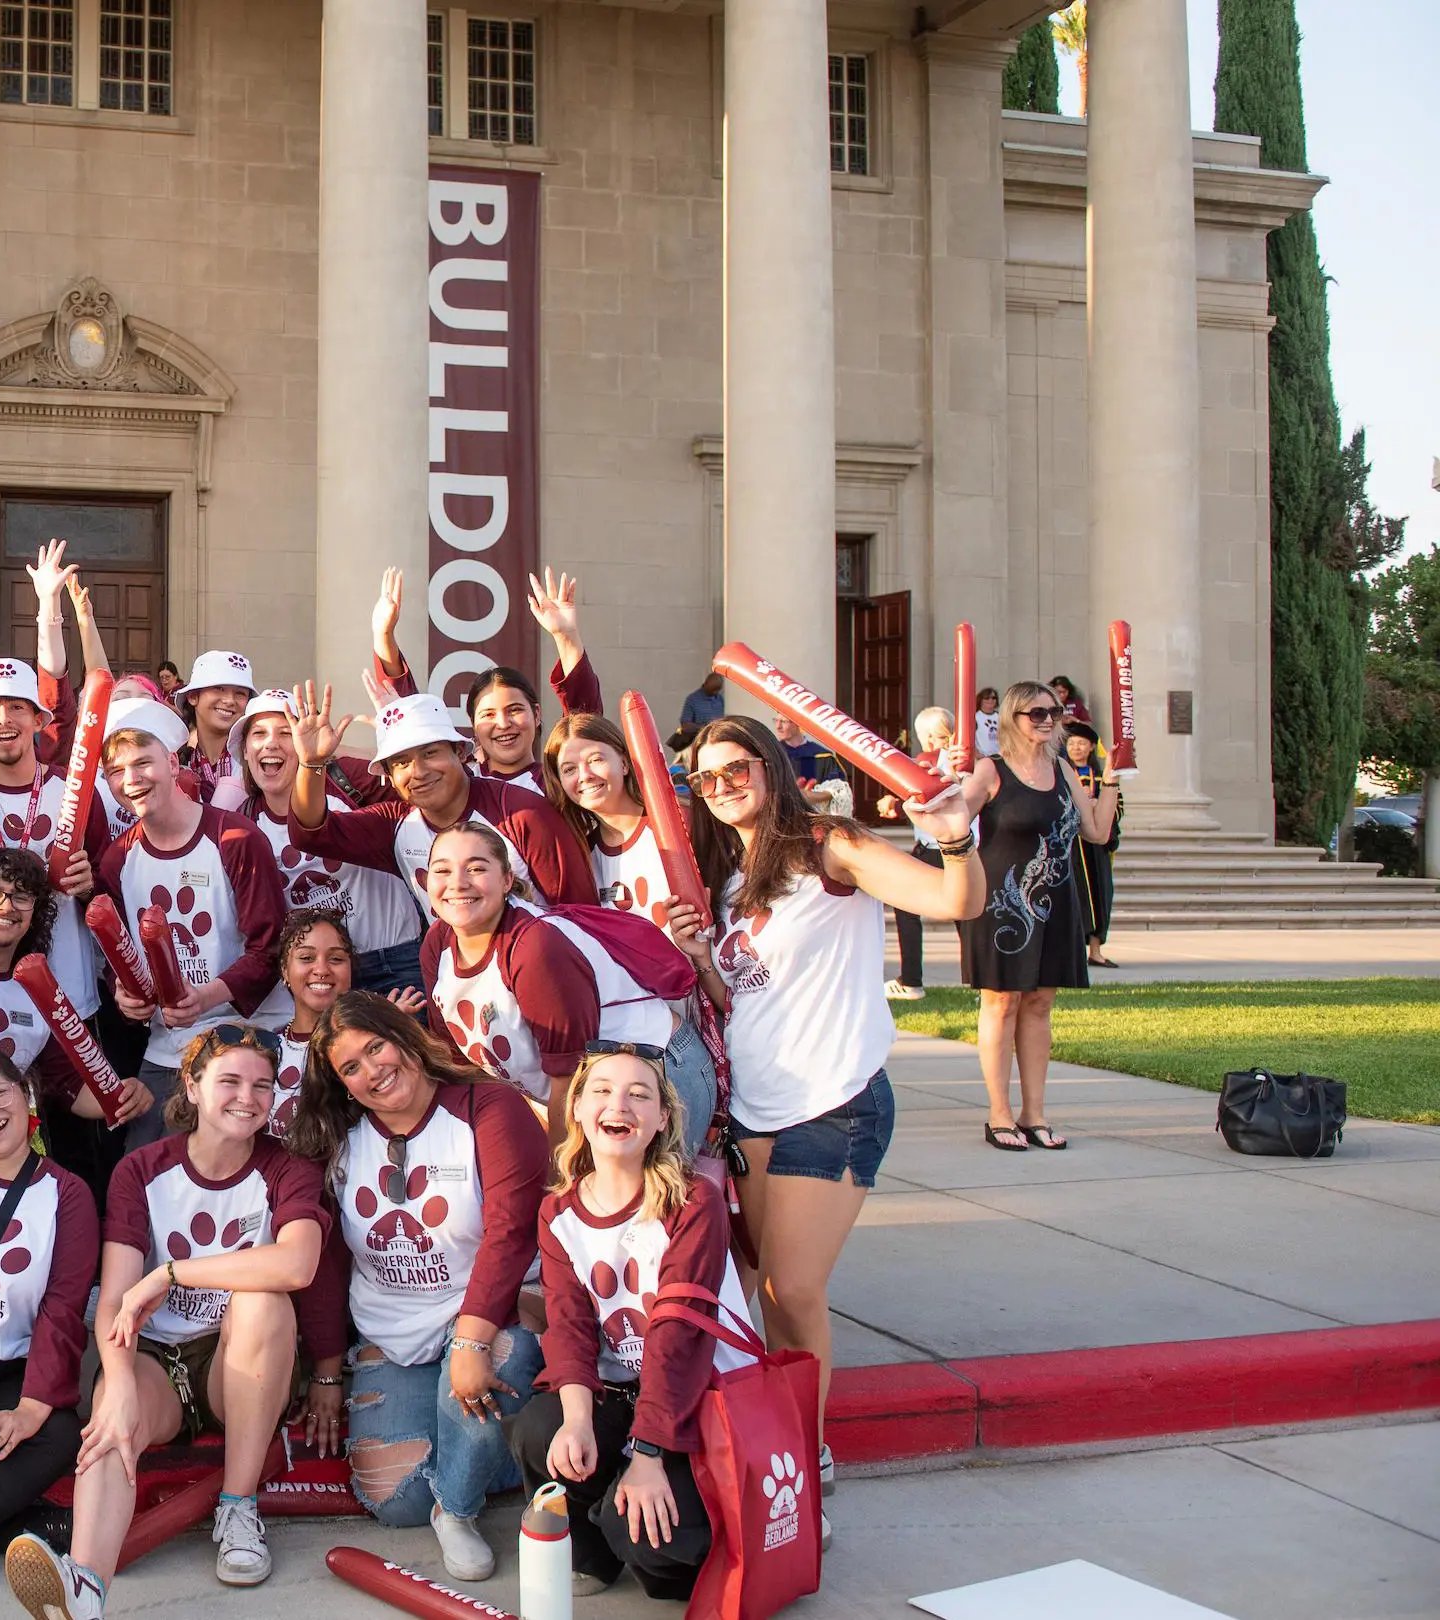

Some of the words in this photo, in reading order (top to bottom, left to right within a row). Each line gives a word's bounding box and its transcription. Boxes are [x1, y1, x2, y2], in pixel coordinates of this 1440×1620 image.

[1118, 667, 1131, 685] GO
[777, 680, 815, 711] GO
[810, 699, 896, 763] DAWGS!
[1119, 689, 1134, 740] DAWGS!
[68, 742, 87, 772] GO
[52, 775, 82, 852] DAWGS!
[198, 959, 208, 969] OF
[58, 1013, 86, 1041] GO
[73, 1037, 121, 1095] DAWGS!
[365, 1254, 426, 1268] UNIVERSITY
[431, 1253, 445, 1265] OF
[764, 1521, 798, 1547] REDLANDS
